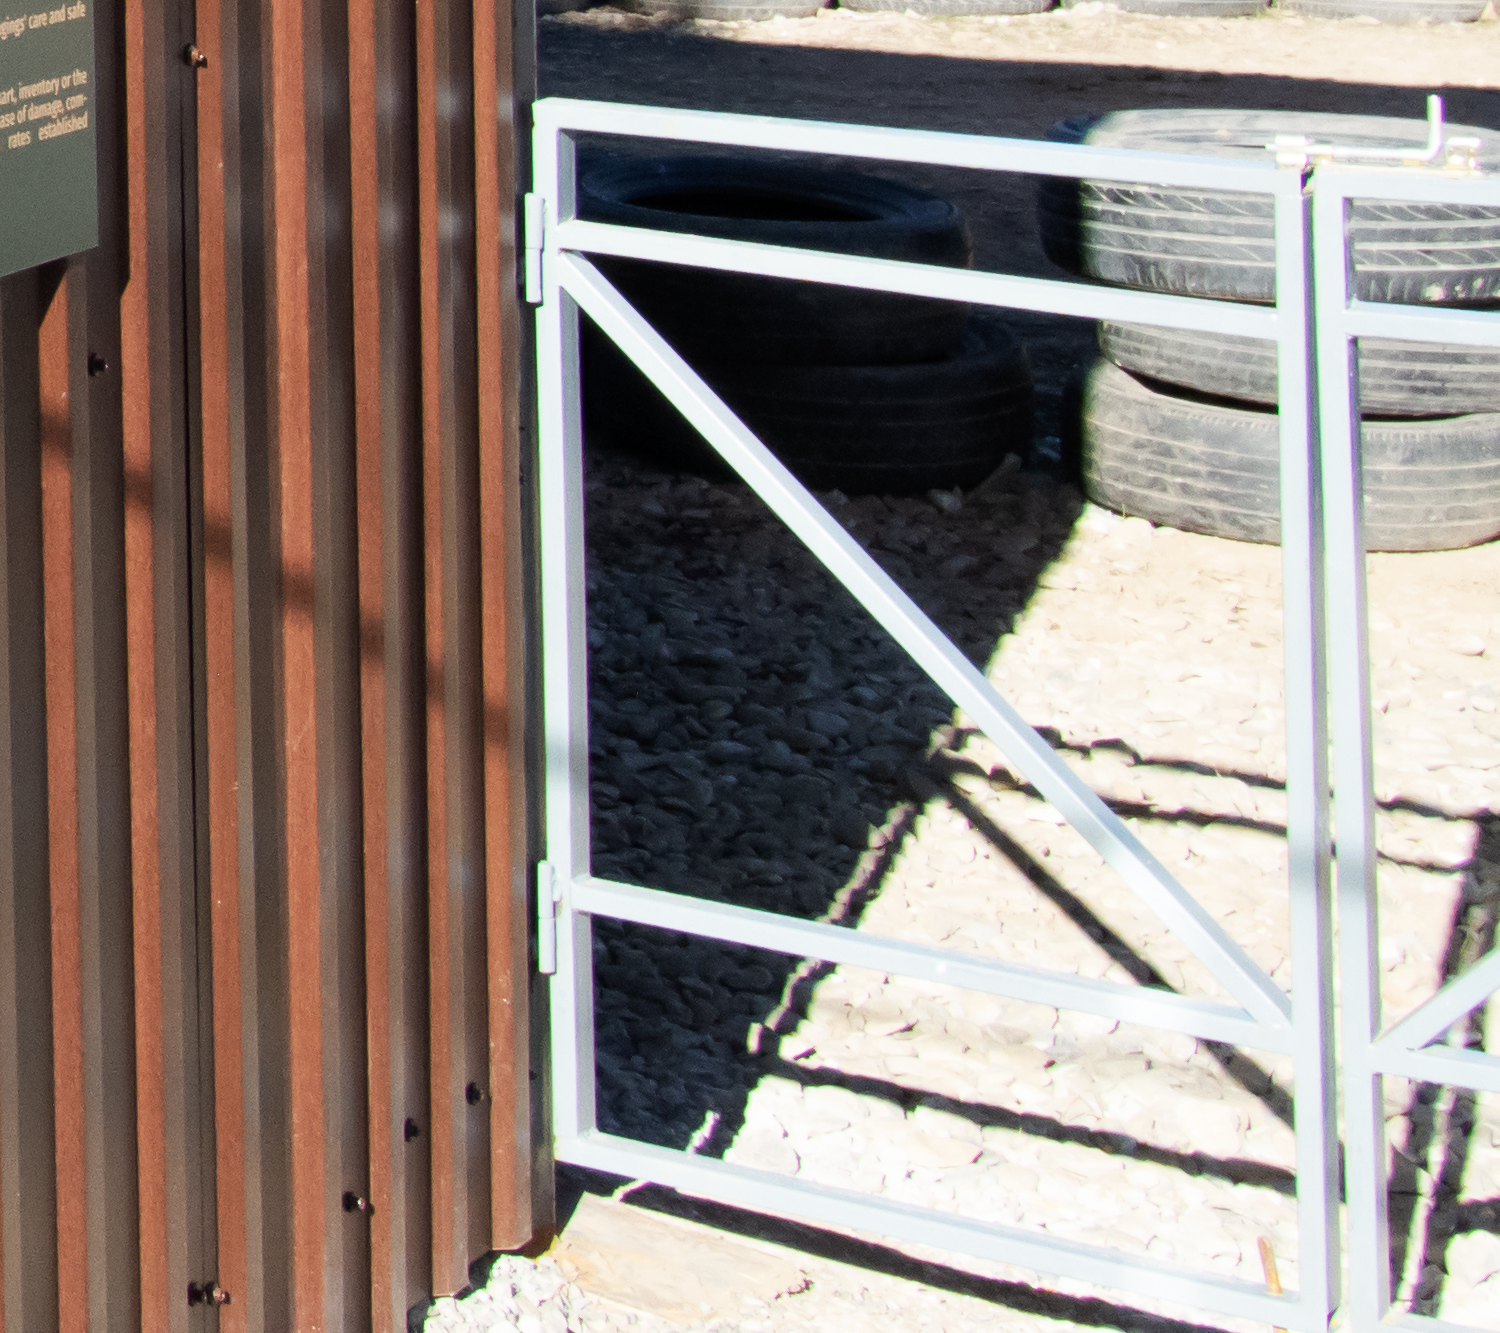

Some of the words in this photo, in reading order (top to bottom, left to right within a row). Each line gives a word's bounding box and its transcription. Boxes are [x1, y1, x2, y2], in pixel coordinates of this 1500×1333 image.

[27, 11, 48, 29] care
[47, 3, 66, 25] and
[66, 0, 86, 21] safe
